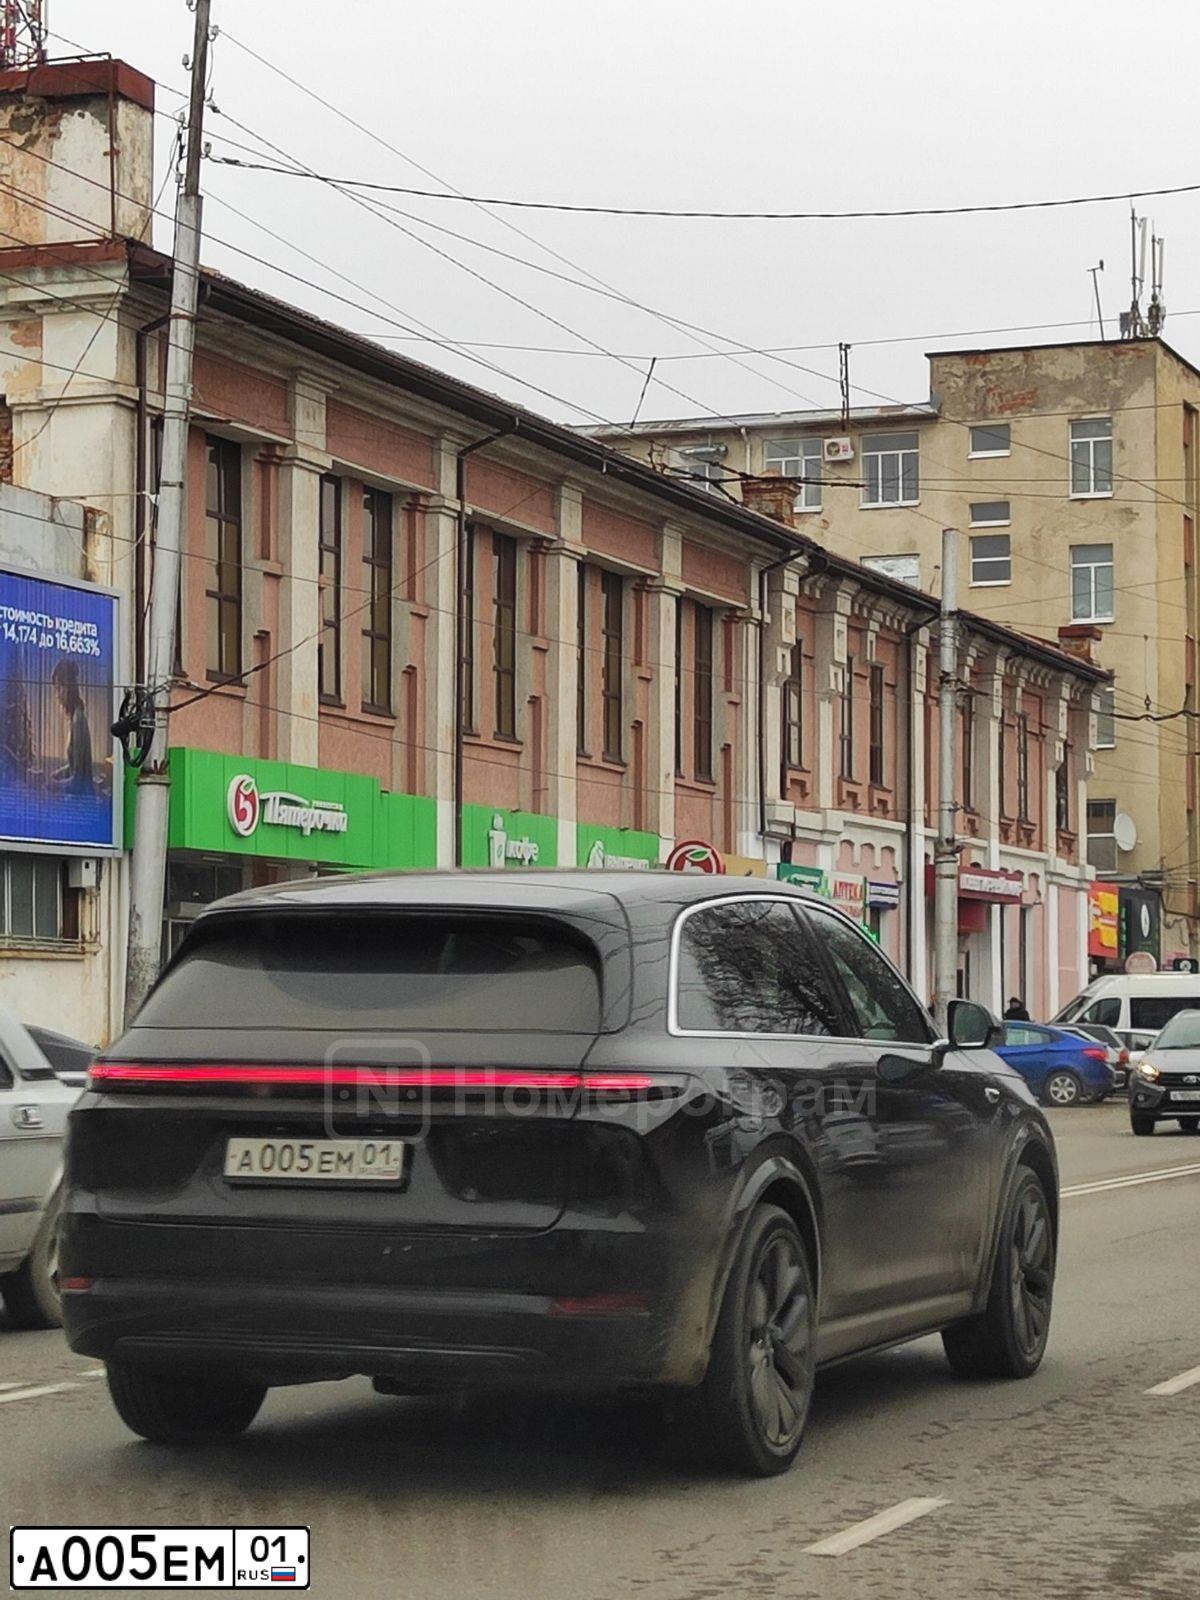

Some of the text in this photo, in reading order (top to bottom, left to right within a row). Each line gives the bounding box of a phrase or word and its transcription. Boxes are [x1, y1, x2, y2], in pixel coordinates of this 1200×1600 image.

[3, 623, 100, 657] 14,174 до 16,663%
[55, 618, 97, 638] кредита
[506, 836, 540, 866] кофе
